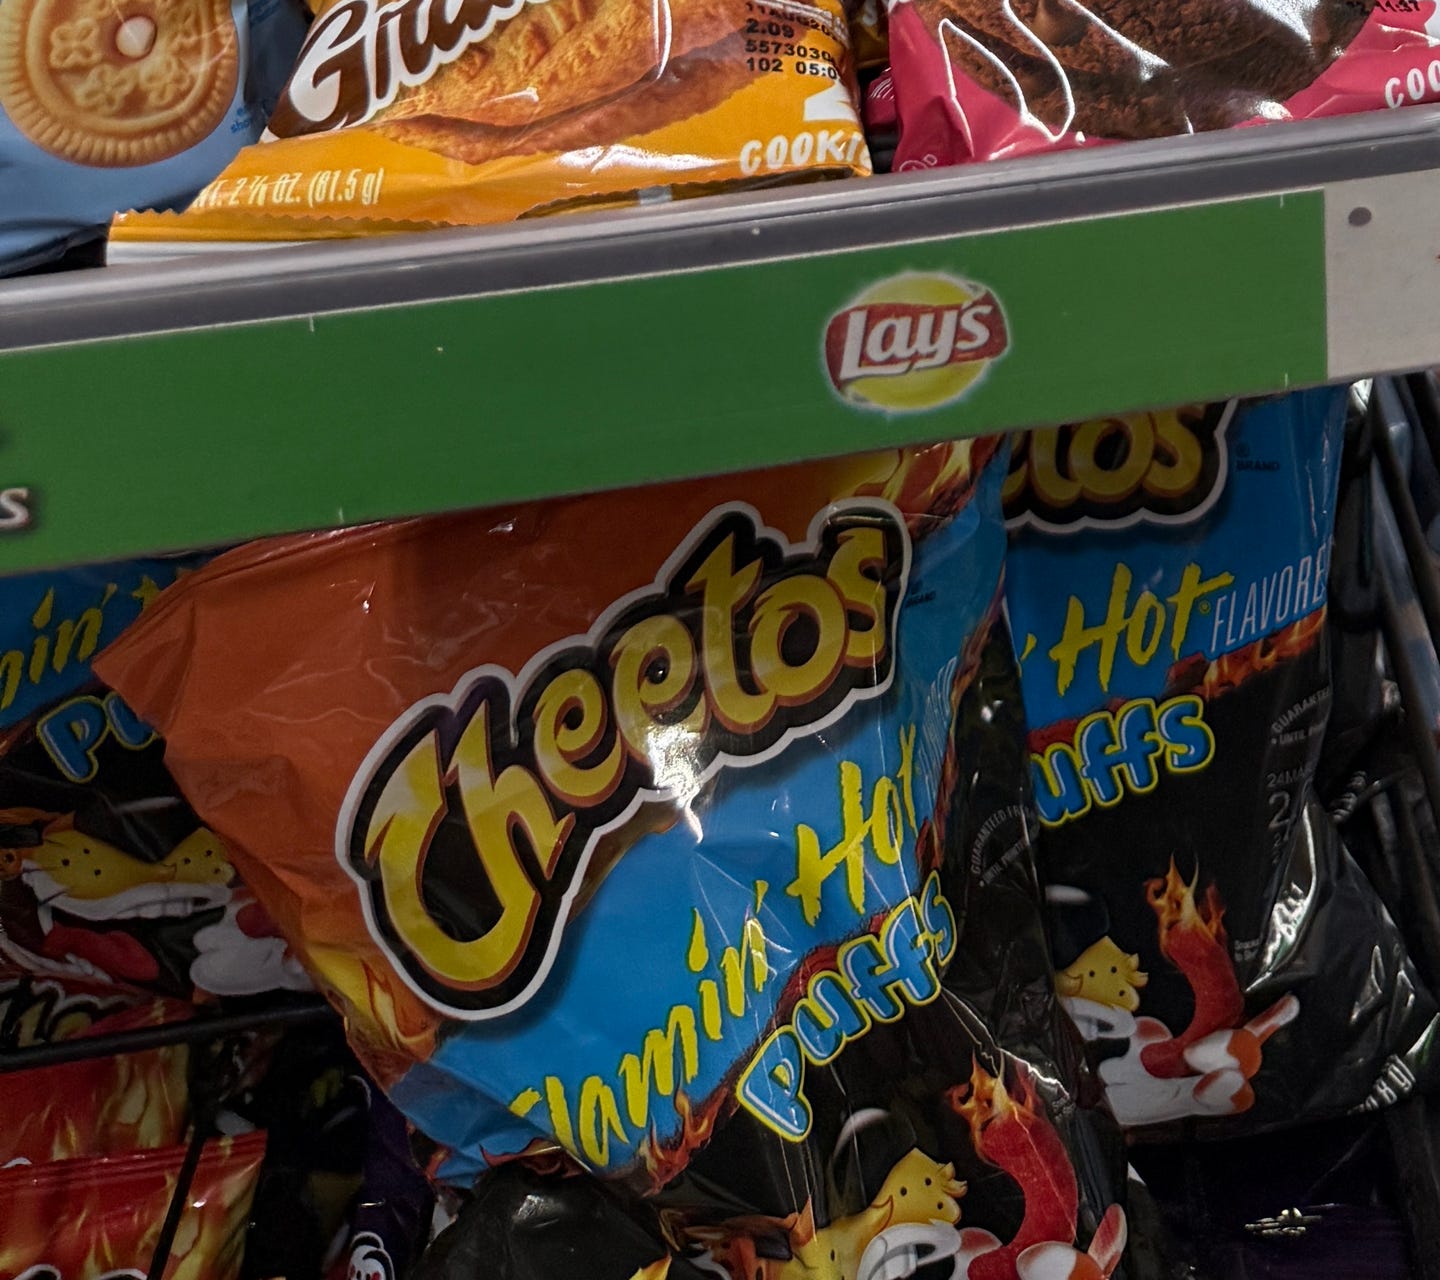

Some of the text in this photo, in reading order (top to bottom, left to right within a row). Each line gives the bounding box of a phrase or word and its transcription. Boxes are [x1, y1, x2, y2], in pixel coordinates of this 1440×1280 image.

[746, 18, 795, 38] 2.09
[746, 58, 783, 73] 102
[838, 302, 994, 382] Lay's
[1048, 561, 1236, 697] Hot
[358, 520, 894, 996] Cheetos
[786, 722, 918, 928] Hot
